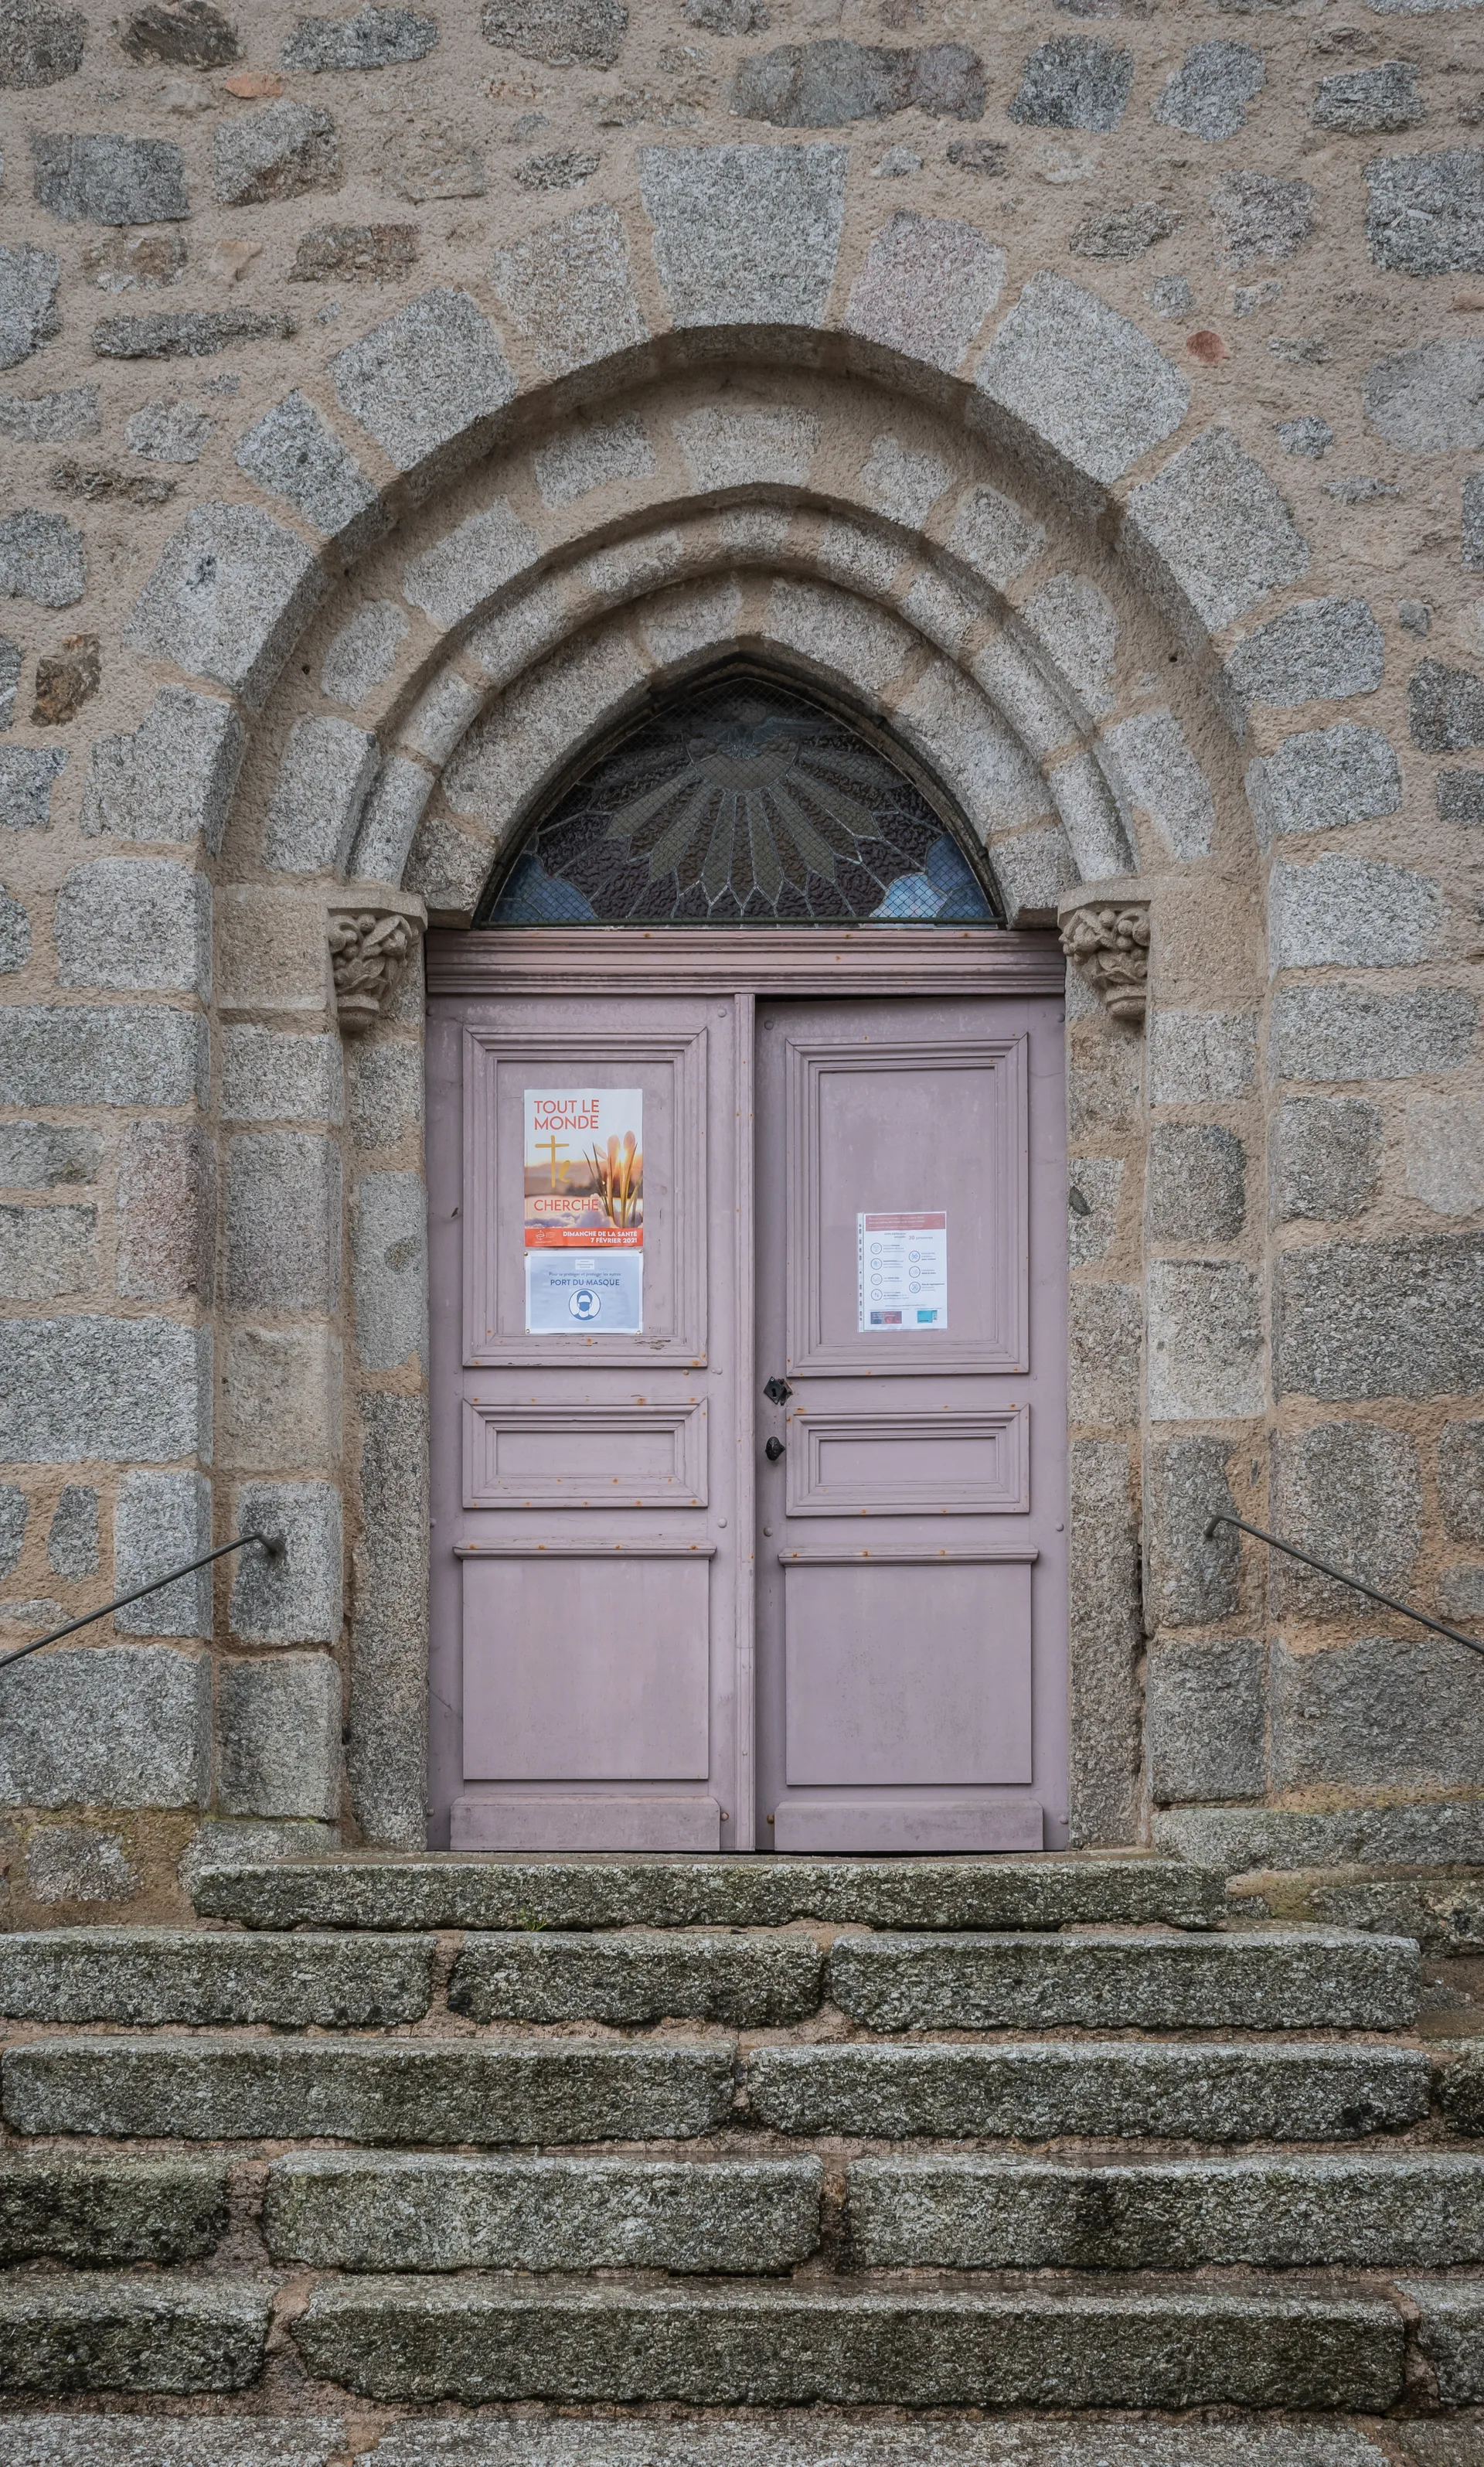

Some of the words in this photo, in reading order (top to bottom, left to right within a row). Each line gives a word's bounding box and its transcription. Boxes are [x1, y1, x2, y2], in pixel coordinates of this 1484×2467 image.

[534, 1100, 577, 1114] TOUT
[582, 1099, 600, 1113] LE
[534, 1115, 599, 1130] MONDE
[533, 1199, 599, 1211] CHERCHE
